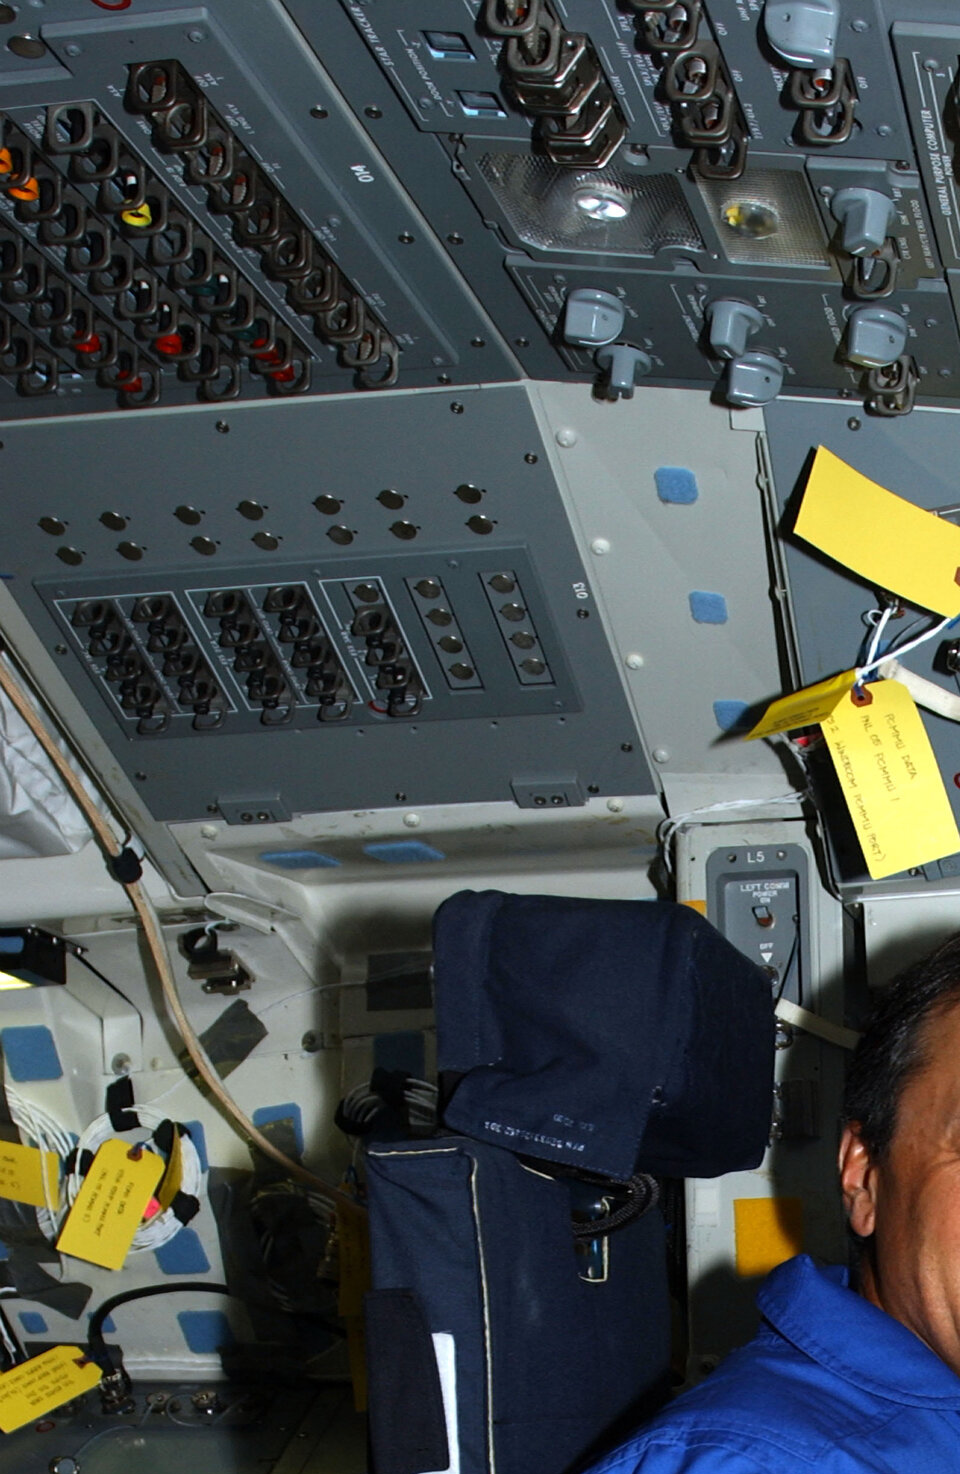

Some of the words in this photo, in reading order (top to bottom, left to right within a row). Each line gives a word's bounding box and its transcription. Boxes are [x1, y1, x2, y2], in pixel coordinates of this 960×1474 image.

[350, 6, 381, 45] TRACKER
[715, 22, 728, 37] OFF
[376, 46, 395, 67] STAR
[616, 41, 631, 60] UHF
[731, 69, 744, 83] OFF
[856, 76, 869, 90] OFF
[920, 109, 940, 151] COMPUTER
[930, 149, 946, 180] PURPOSE
[938, 180, 953, 217] GENERAL
[884, 712, 906, 752] PCMMU
[901, 754, 918, 780] DATA
[875, 752, 897, 793] PCMMU
[747, 851, 765, 863] L5
[740, 882, 761, 892] LEFT
[764, 881, 790, 889] COMM
[752, 890, 778, 898] POWER
[760, 942, 774, 950] OFF
